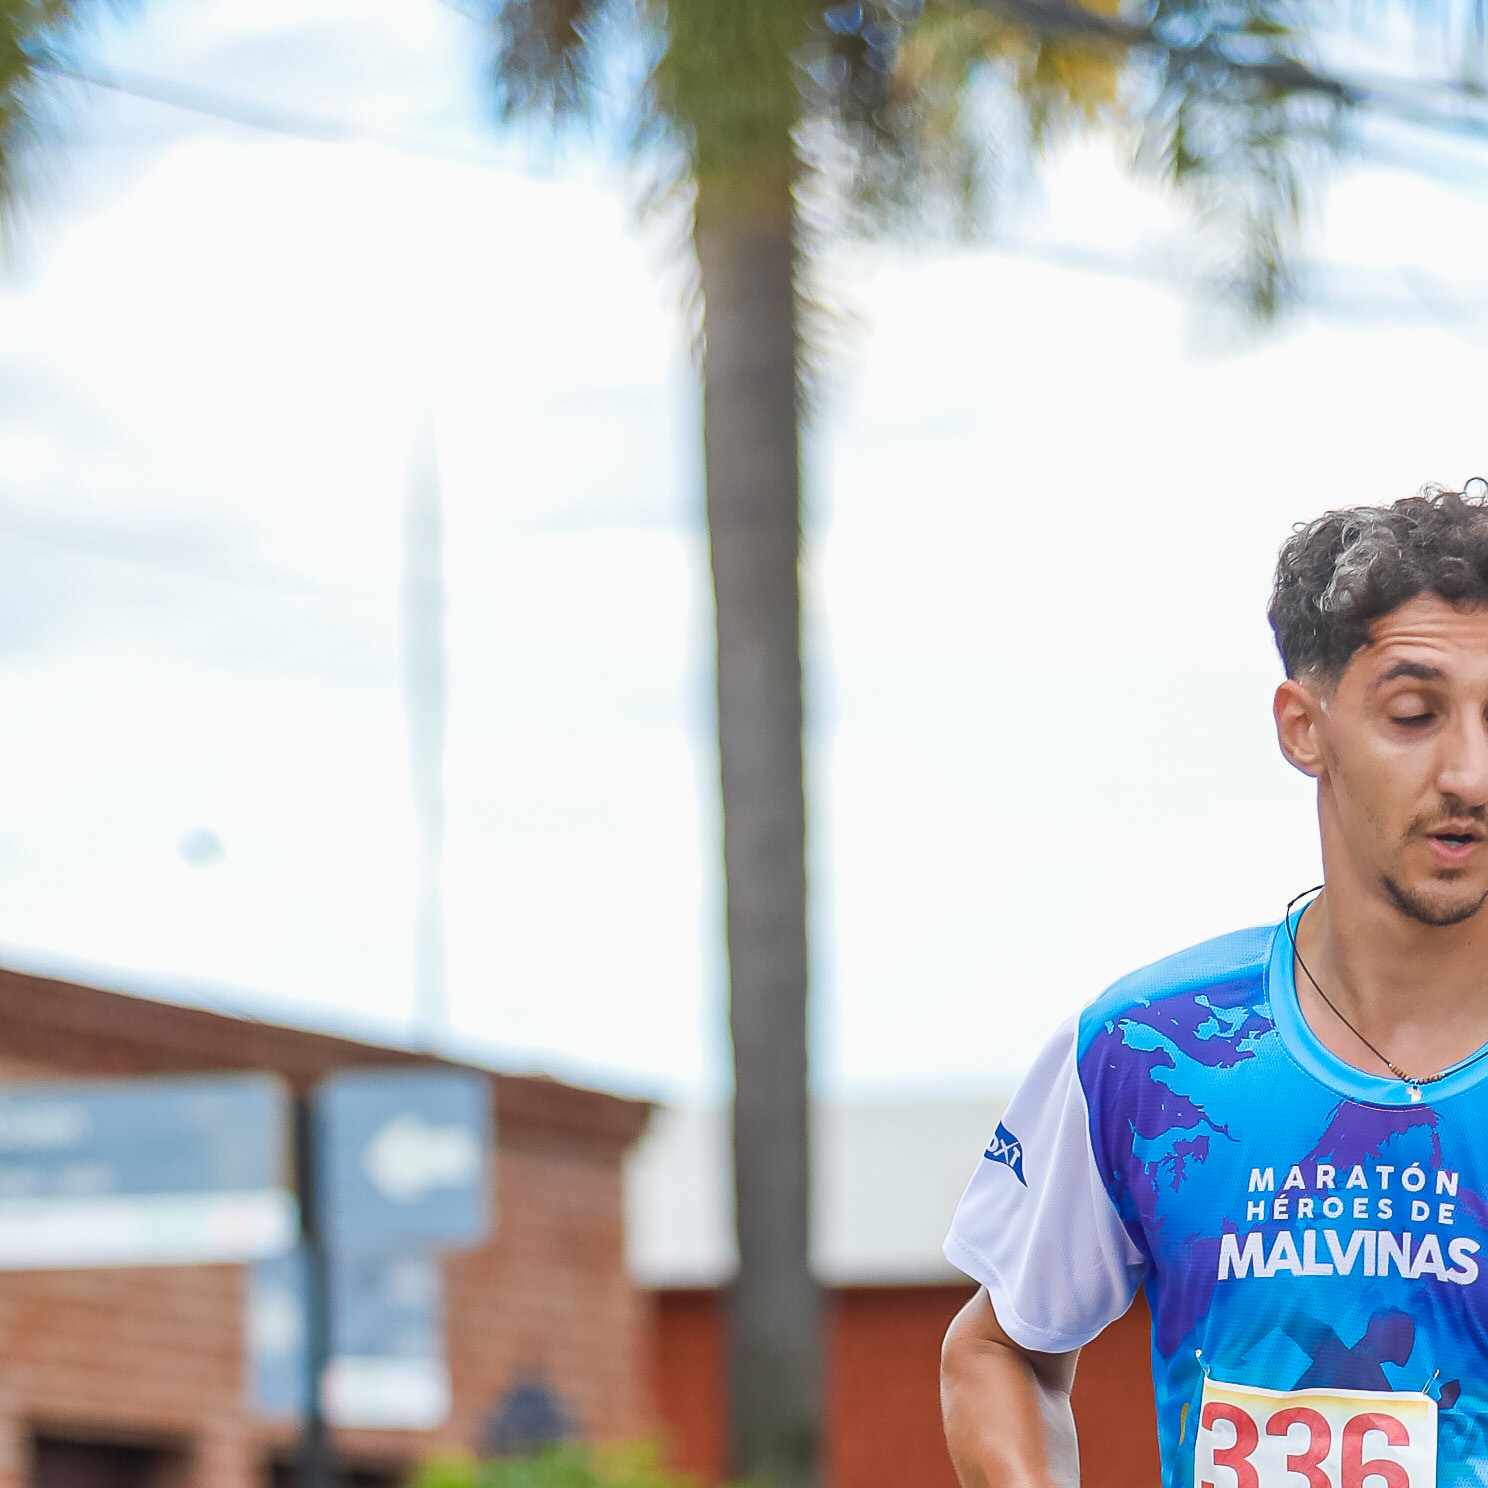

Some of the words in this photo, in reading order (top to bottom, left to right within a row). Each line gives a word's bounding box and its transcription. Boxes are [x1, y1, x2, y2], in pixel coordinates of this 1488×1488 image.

[1248, 1162, 1459, 1197] MARATÓN
[1246, 1194, 1393, 1222] HÉROES
[1411, 1199, 1456, 1225] DE
[1217, 1229, 1481, 1286] MALVINAS
